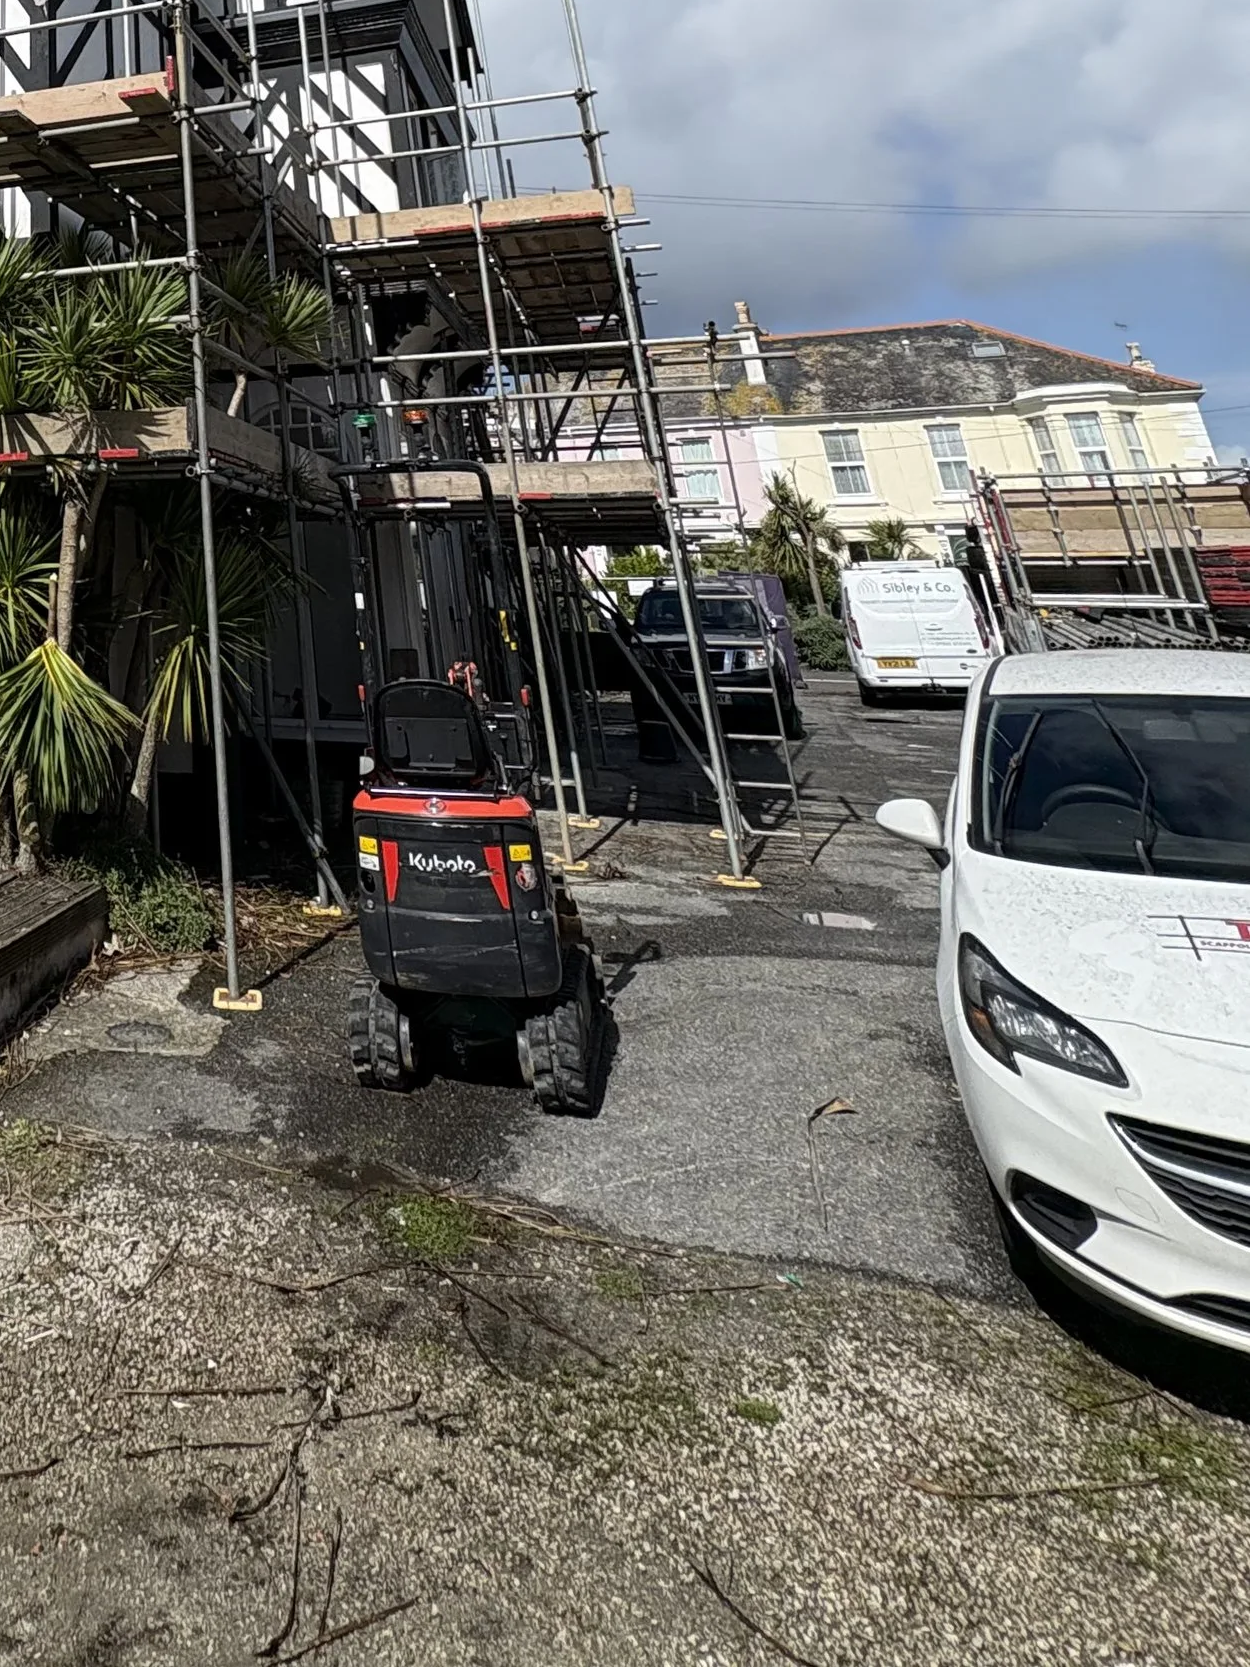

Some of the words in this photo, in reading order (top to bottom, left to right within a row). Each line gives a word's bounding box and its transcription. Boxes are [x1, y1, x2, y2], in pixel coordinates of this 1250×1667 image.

[882, 582, 920, 594] Sibley
[923, 582, 933, 592] &
[935, 582, 956, 593] Co.
[408, 852, 476, 874] Kubota
